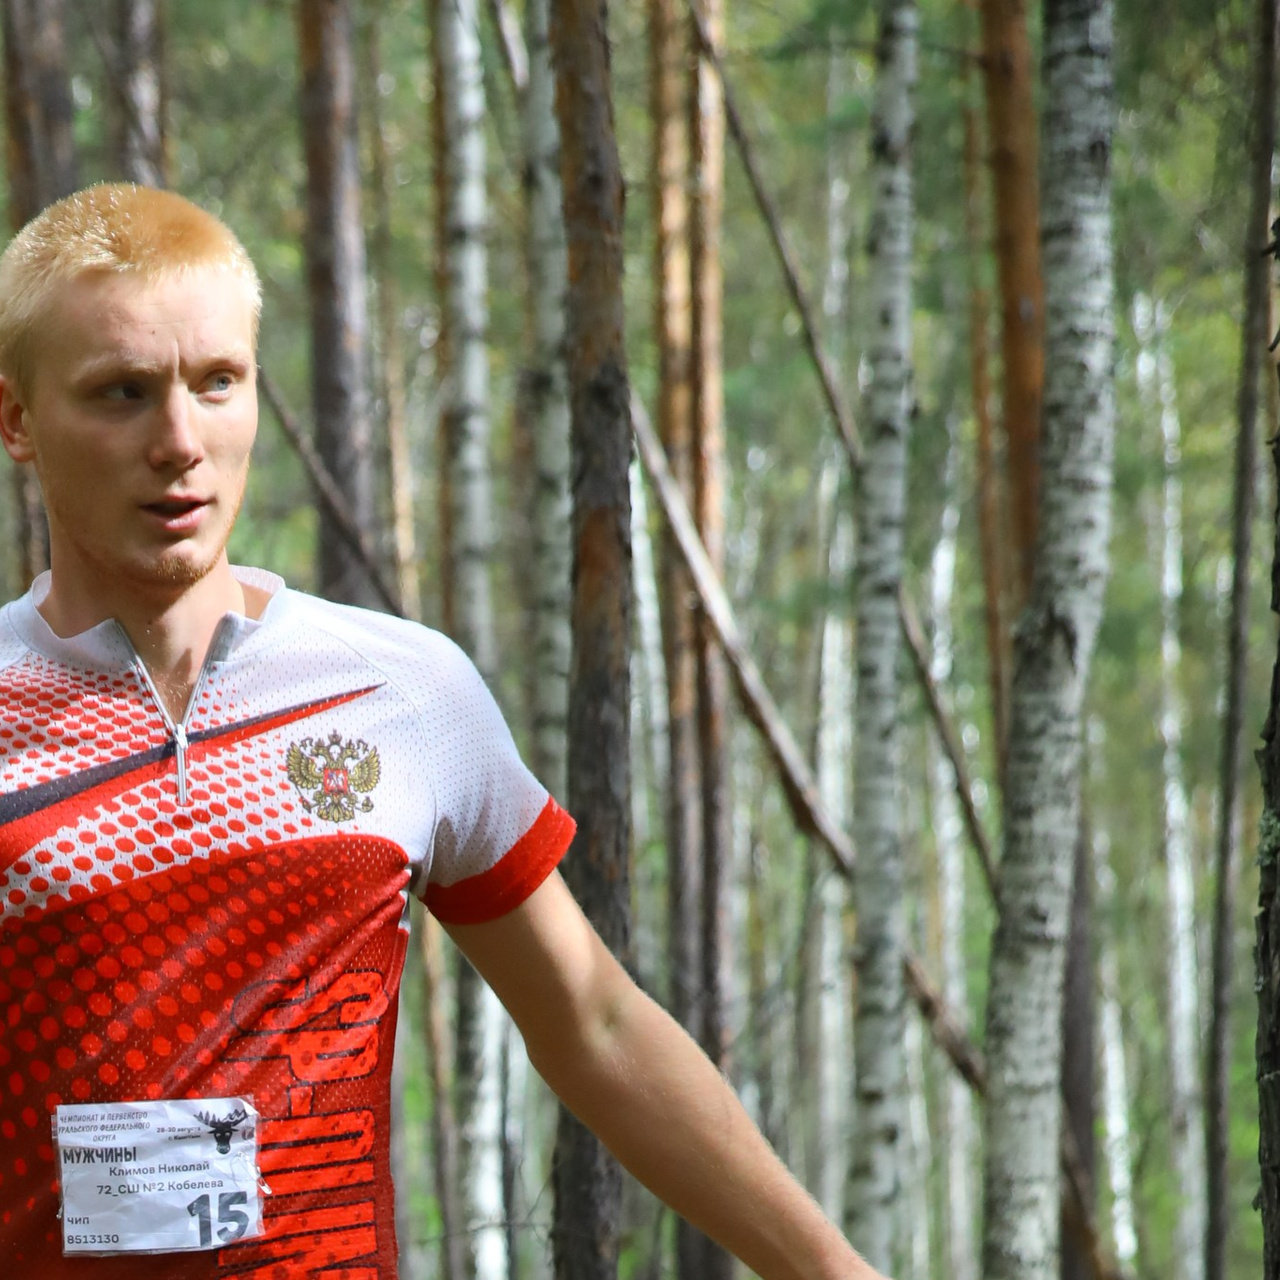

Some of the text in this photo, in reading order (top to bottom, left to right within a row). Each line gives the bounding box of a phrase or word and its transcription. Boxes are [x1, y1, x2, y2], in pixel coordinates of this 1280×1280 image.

[60, 1111, 148, 1124] ЧЕМПИОНАТ И ПЕРВЕНСТВО
[100, 1121, 151, 1132] ФЕДЕРАЛЬНОГО
[92, 1134, 117, 1143] ОКРУГА
[62, 1146, 137, 1164] МУЖЧИНЫ
[109, 1161, 210, 1177] Климов Николай
[96, 1179, 224, 1197] 72_СШ №2 Кобелева
[67, 1216, 90, 1225] чип
[187, 1190, 250, 1248] 15
[66, 1233, 119, 1245] 8513130
